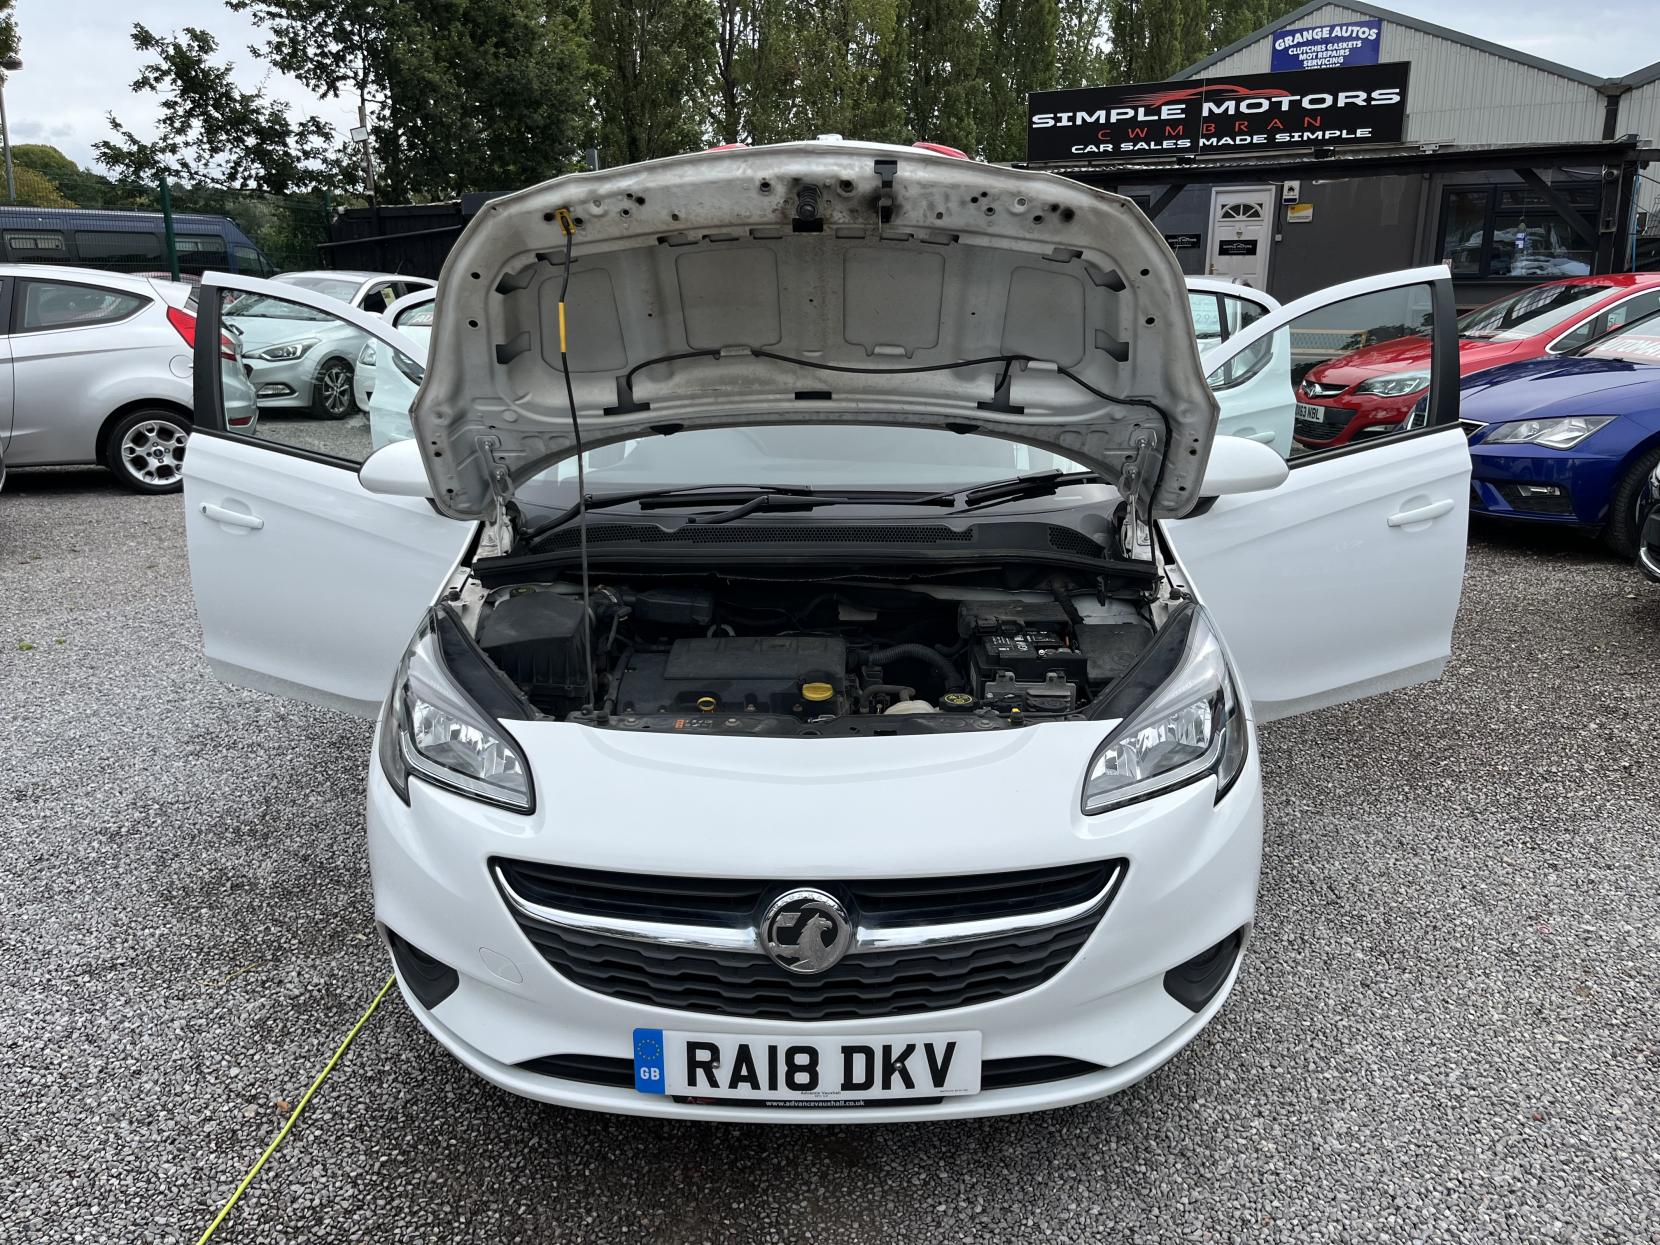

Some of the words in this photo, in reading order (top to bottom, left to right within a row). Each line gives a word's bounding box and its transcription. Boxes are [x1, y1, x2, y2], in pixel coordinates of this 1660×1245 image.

[1275, 27, 1330, 50] GRANGE
[1331, 26, 1378, 40] AUTOS
[1288, 44, 1326, 55] CLUTCHES
[1327, 40, 1362, 51] GASKETS
[1299, 52, 1317, 61] MOT
[1318, 49, 1350, 58] REPAIRS
[1303, 56, 1344, 67] SERVICING
[1031, 104, 1186, 128] SIMPLE
[1202, 88, 1401, 117] MOTORS
[1097, 116, 1322, 140] CWMBRAN
[1071, 142, 1113, 154] CAR
[1120, 138, 1191, 152] SALES
[1199, 134, 1272, 147] MADE
[1274, 128, 1372, 142] SIMPLE
[640, 1067, 660, 1081] GB
[686, 1040, 820, 1092] RA18
[840, 1041, 957, 1092] DKV
[766, 1099, 865, 1107] www.advancevauxhall.co.uk
